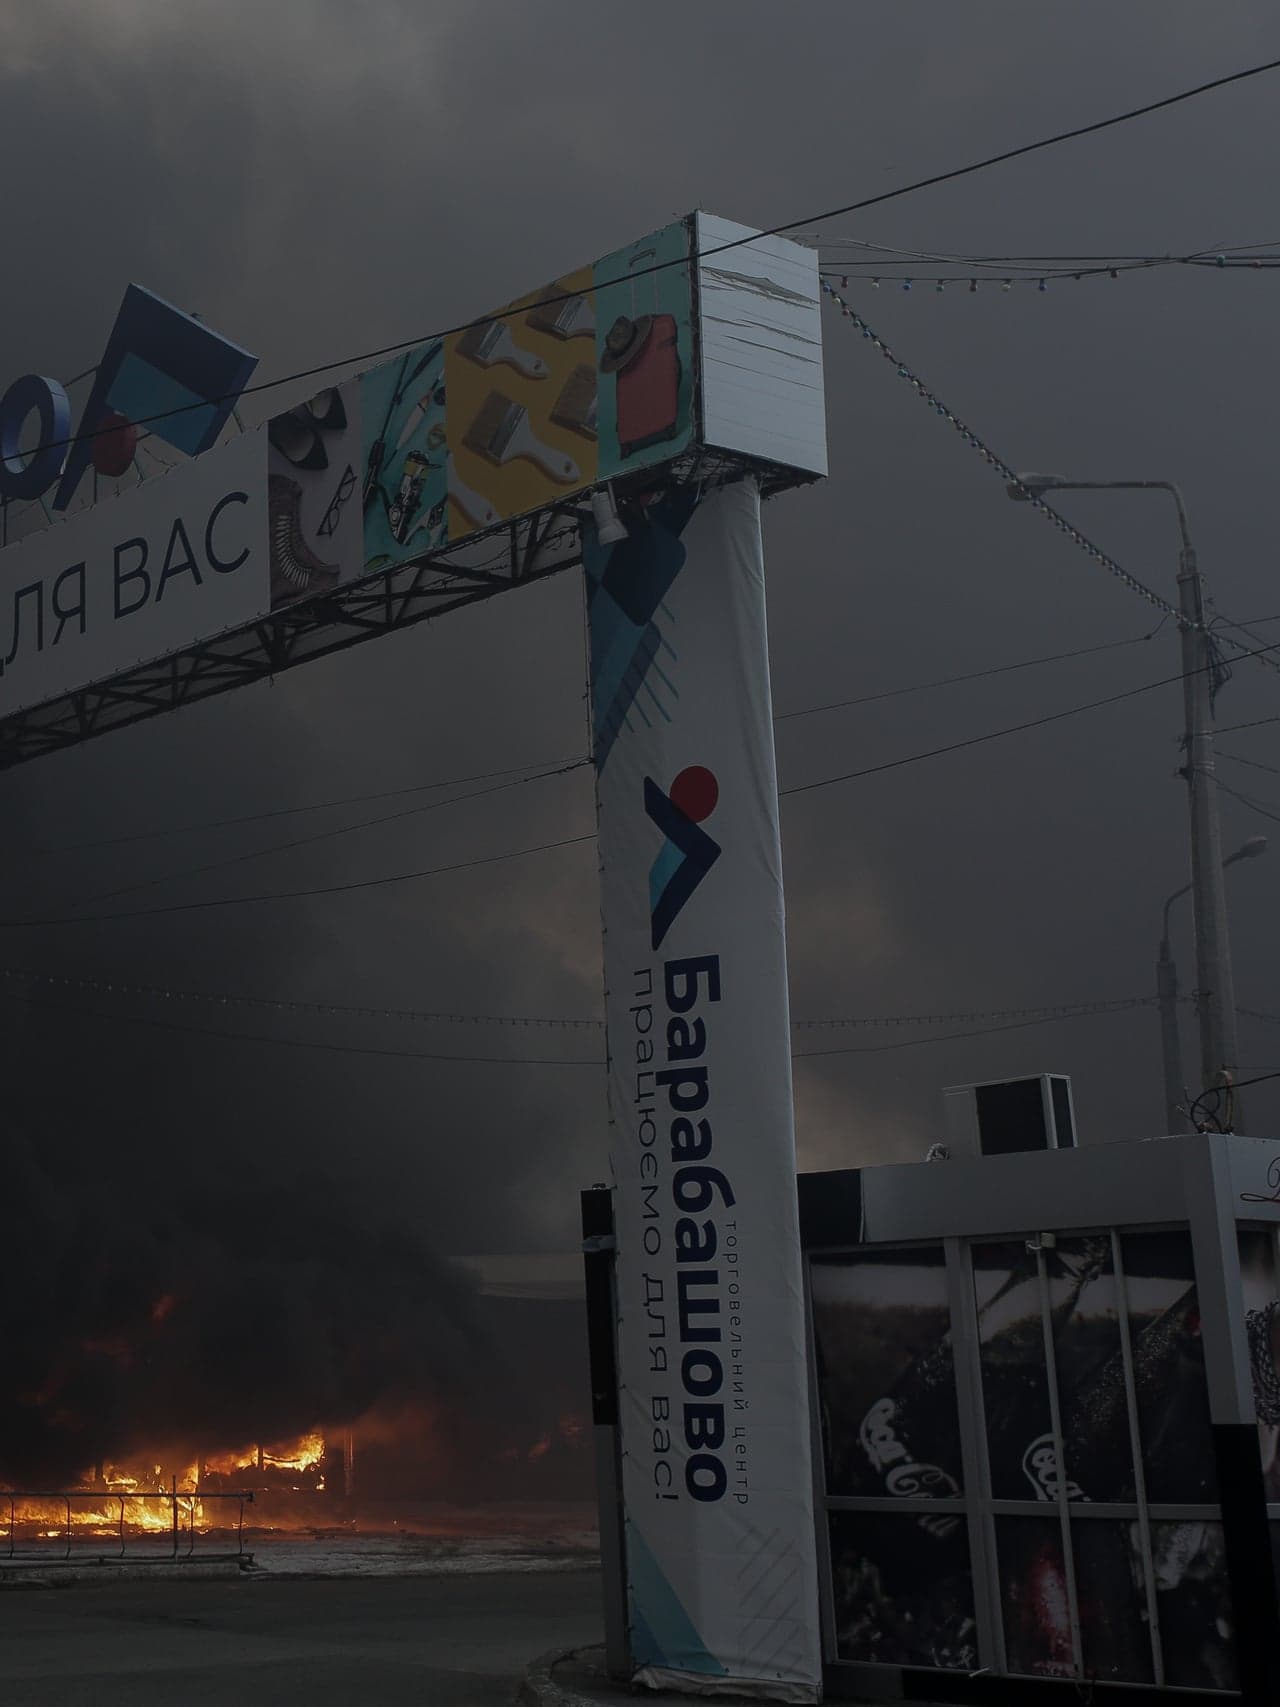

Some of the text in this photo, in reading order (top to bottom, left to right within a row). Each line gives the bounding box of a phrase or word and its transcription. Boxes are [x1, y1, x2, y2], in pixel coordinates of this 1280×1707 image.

[114, 490, 251, 620] ВАС
[632, 968, 679, 1502] працюємо для вас!
[654, 953, 738, 1504] Барабашово
[724, 1220, 751, 1506] торговельний центр
